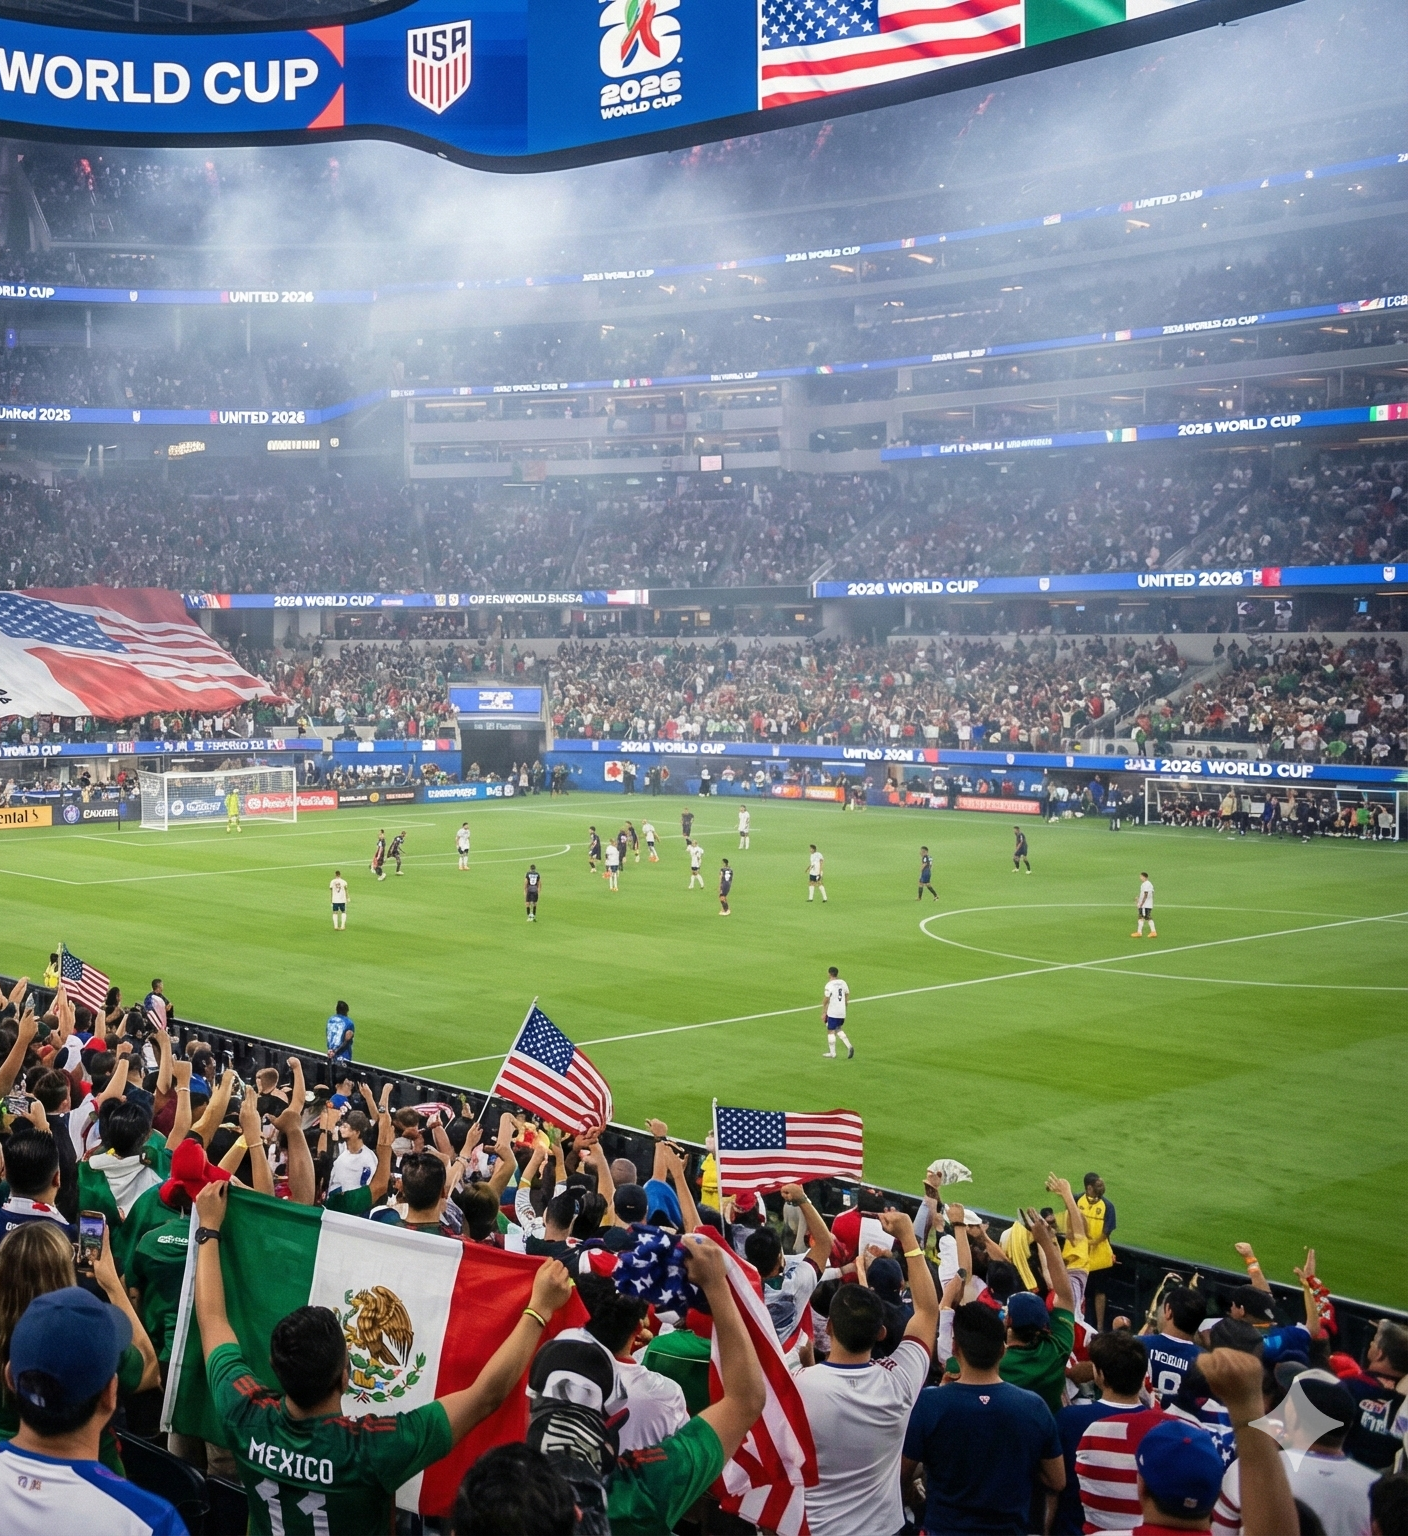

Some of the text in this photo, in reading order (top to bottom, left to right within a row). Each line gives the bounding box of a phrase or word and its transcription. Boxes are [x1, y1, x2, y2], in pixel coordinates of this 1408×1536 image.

[412, 26, 467, 62] USA
[203, 58, 319, 105] CUP
[600, 70, 681, 107] 2026
[601, 94, 682, 120] WORLD CUP
[28, 286, 56, 299] CUP
[229, 291, 315, 303] UNITED 2026
[219, 411, 306, 425] UNITED 2026
[1178, 415, 1301, 436] 2026 WORLD CUP
[847, 580, 980, 596] 2026 WORLD CUP
[1137, 571, 1244, 588] UNITED 2026
[349, 595, 376, 608] CUP
[1160, 761, 1202, 773] 2026
[1207, 761, 1272, 777] WORLD
[1276, 765, 1314, 779] CUP
[248, 1436, 334, 1485] MEXICO
